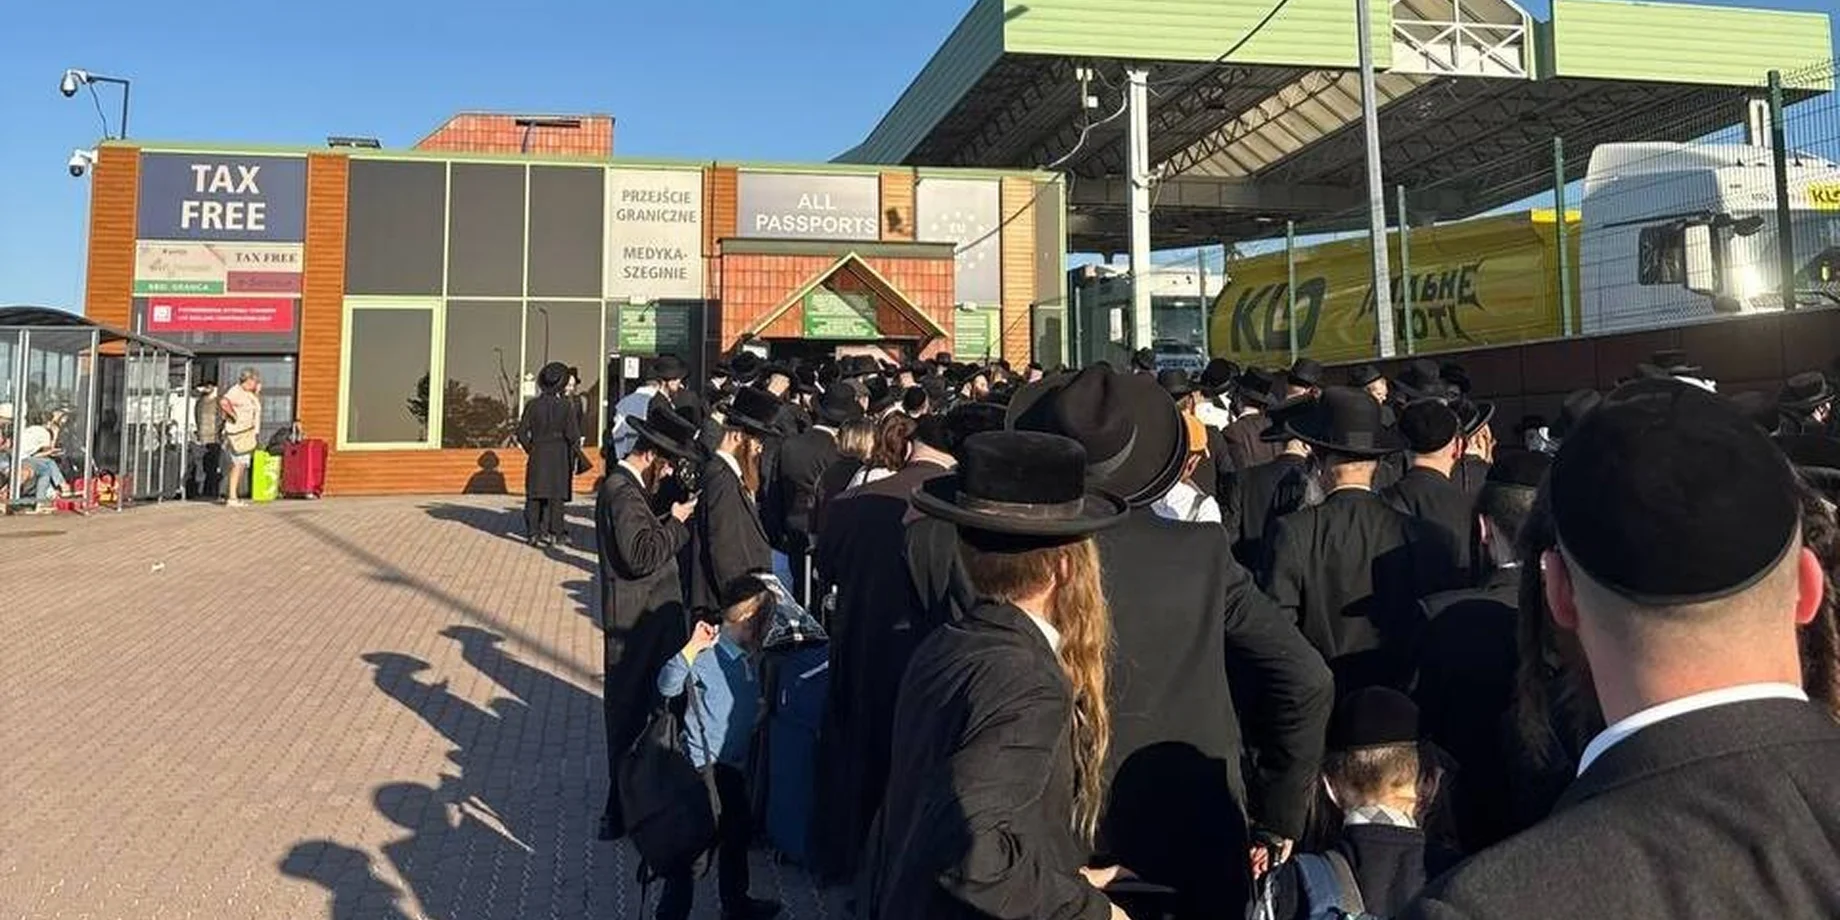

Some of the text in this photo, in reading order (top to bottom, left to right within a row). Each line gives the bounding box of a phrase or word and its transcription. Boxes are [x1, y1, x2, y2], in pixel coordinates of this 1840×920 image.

[191, 164, 261, 194] TAX
[621, 187, 691, 205] PRZEJŚCIE
[797, 193, 837, 211] ALL
[181, 200, 266, 231] FREE
[616, 208, 697, 223] GRANICZNE
[756, 214, 877, 235] PASSPORTS
[235, 252, 297, 263] TAX FREE
[623, 245, 688, 261] MEDYKA-
[623, 265, 688, 280] SZEGINIE
